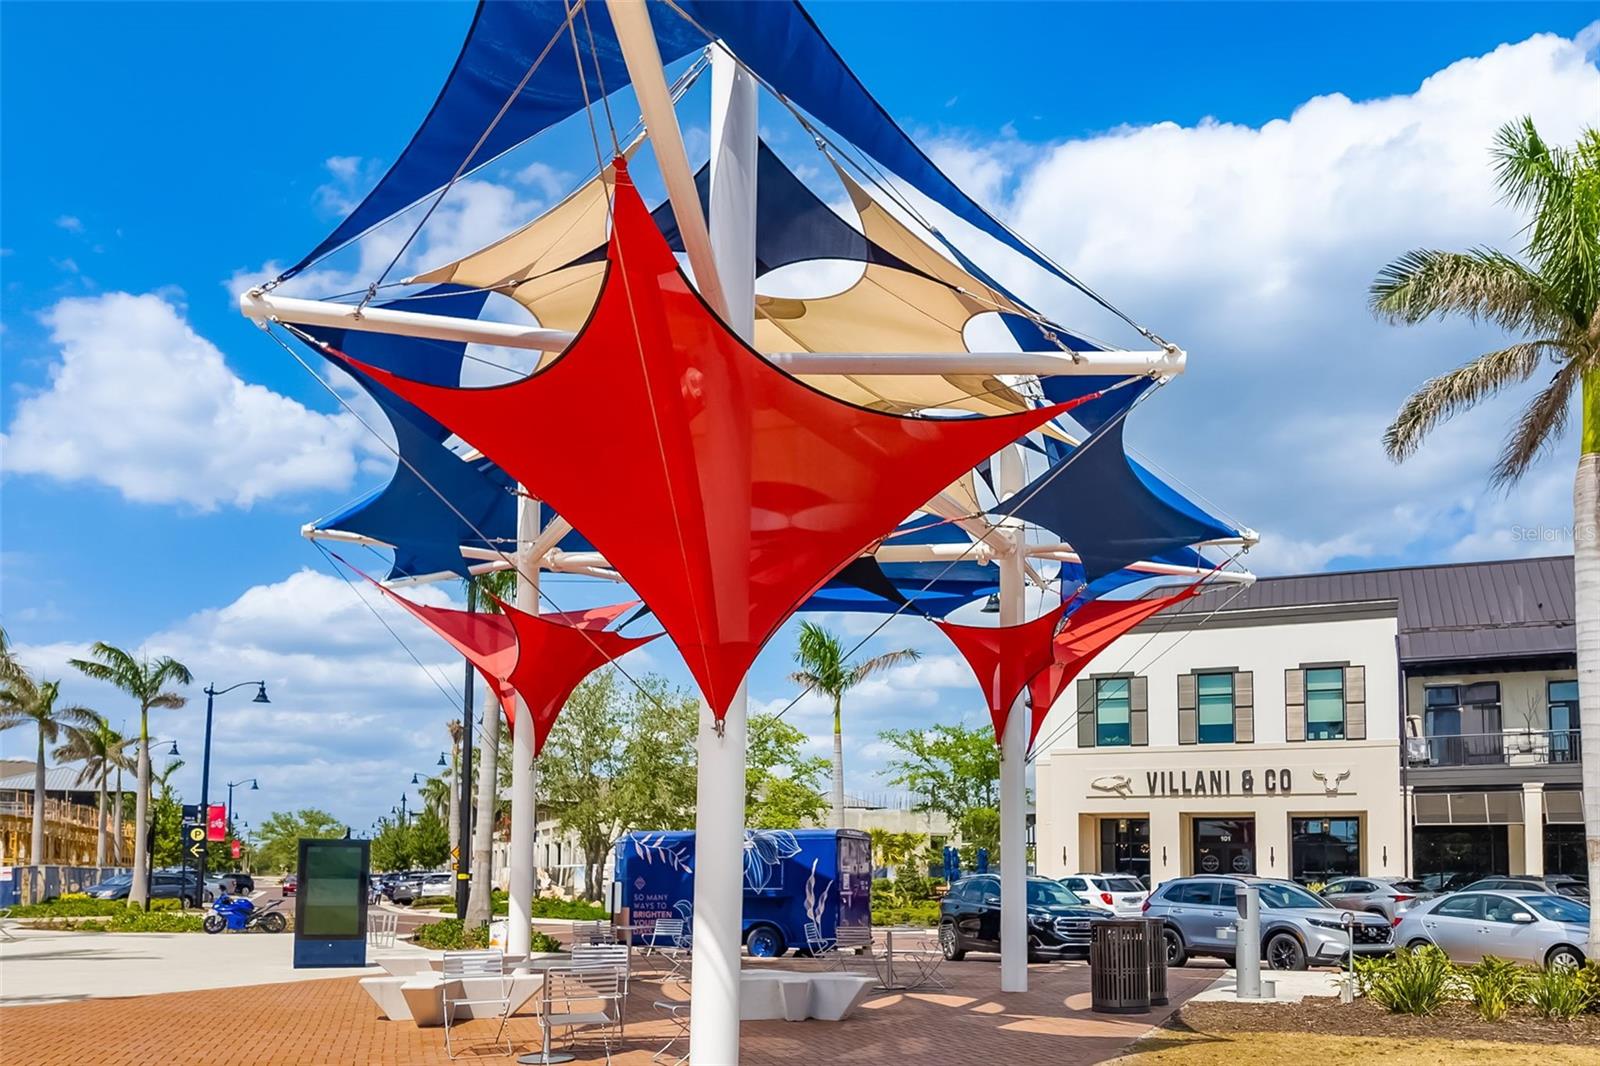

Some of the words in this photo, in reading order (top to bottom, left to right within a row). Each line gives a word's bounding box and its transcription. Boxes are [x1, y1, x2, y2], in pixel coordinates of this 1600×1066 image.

[1146, 770, 1230, 796] VILLANI
[1241, 768, 1254, 796] &
[1265, 768, 1291, 795] CO
[633, 893, 644, 901] SO
[646, 893, 668, 901] MANY
[633, 910, 673, 918] BRIGHTEN
